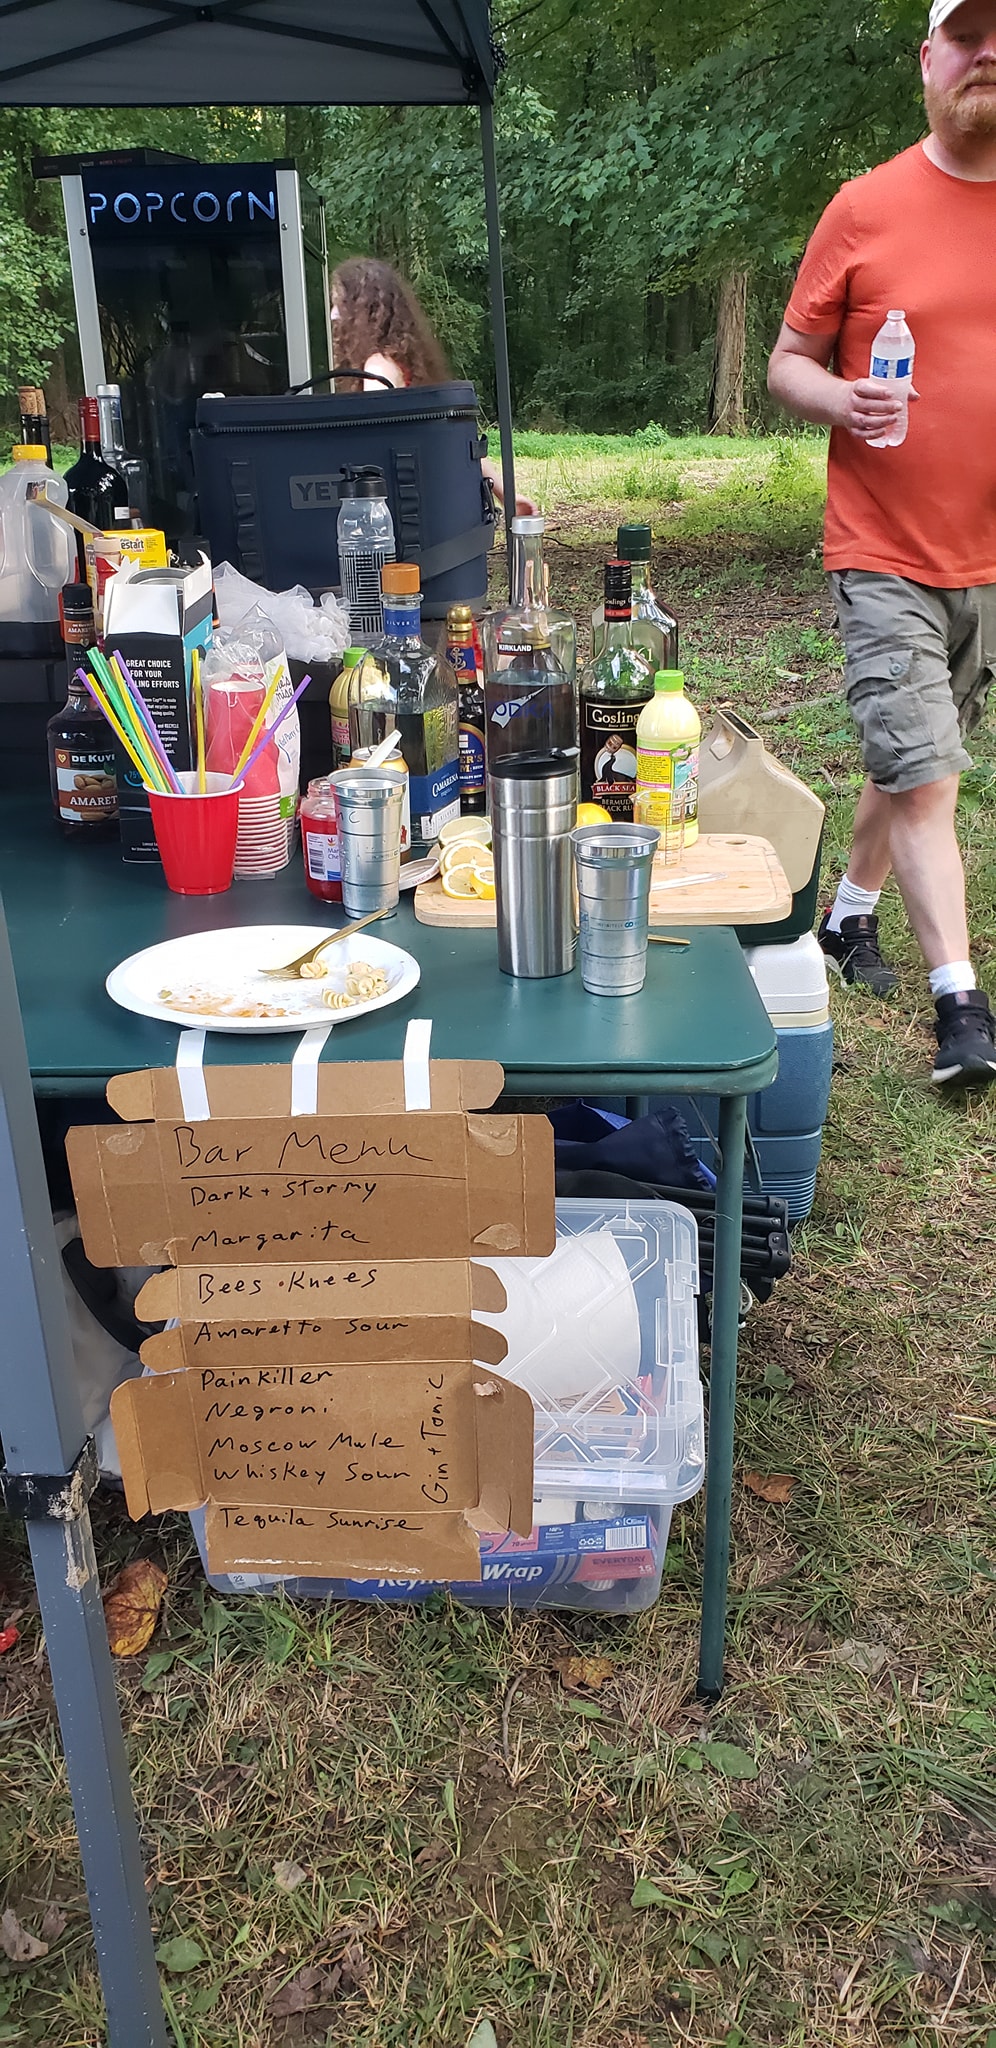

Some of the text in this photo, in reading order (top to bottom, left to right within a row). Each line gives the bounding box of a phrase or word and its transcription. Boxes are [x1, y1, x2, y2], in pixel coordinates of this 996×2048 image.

[296, 481, 341, 501] YET
[498, 644, 532, 652] KIRKLAND
[126, 660, 172, 668] GREAT CHOICE
[131, 670, 162, 678] FOR YOUR
[151, 681, 180, 689] EFFORTS
[495, 702, 554, 718] ODKA
[591, 709, 641, 727] Gosling
[69, 796, 118, 806] AMARET
[602, 798, 632, 806] BERMUD
[173, 1126, 434, 1168] Bar Menu
[191, 1179, 377, 1207] Dark + Stormy
[191, 1220, 370, 1252] Margarita
[199, 1268, 378, 1305] Bees Knees
[193, 1318, 409, 1346] Amaretto Sour
[204, 1398, 334, 1422] Negroni
[420, 1373, 447, 1441] Tonic
[208, 1432, 405, 1458] Moscow Mule
[345, 1462, 411, 1482] Sour
[421, 1463, 449, 1504] Gin
[219, 1507, 424, 1531] Tequila Sunrise
[592, 1555, 646, 1565] EVERYDAY
[482, 1563, 543, 1581] Wrap
